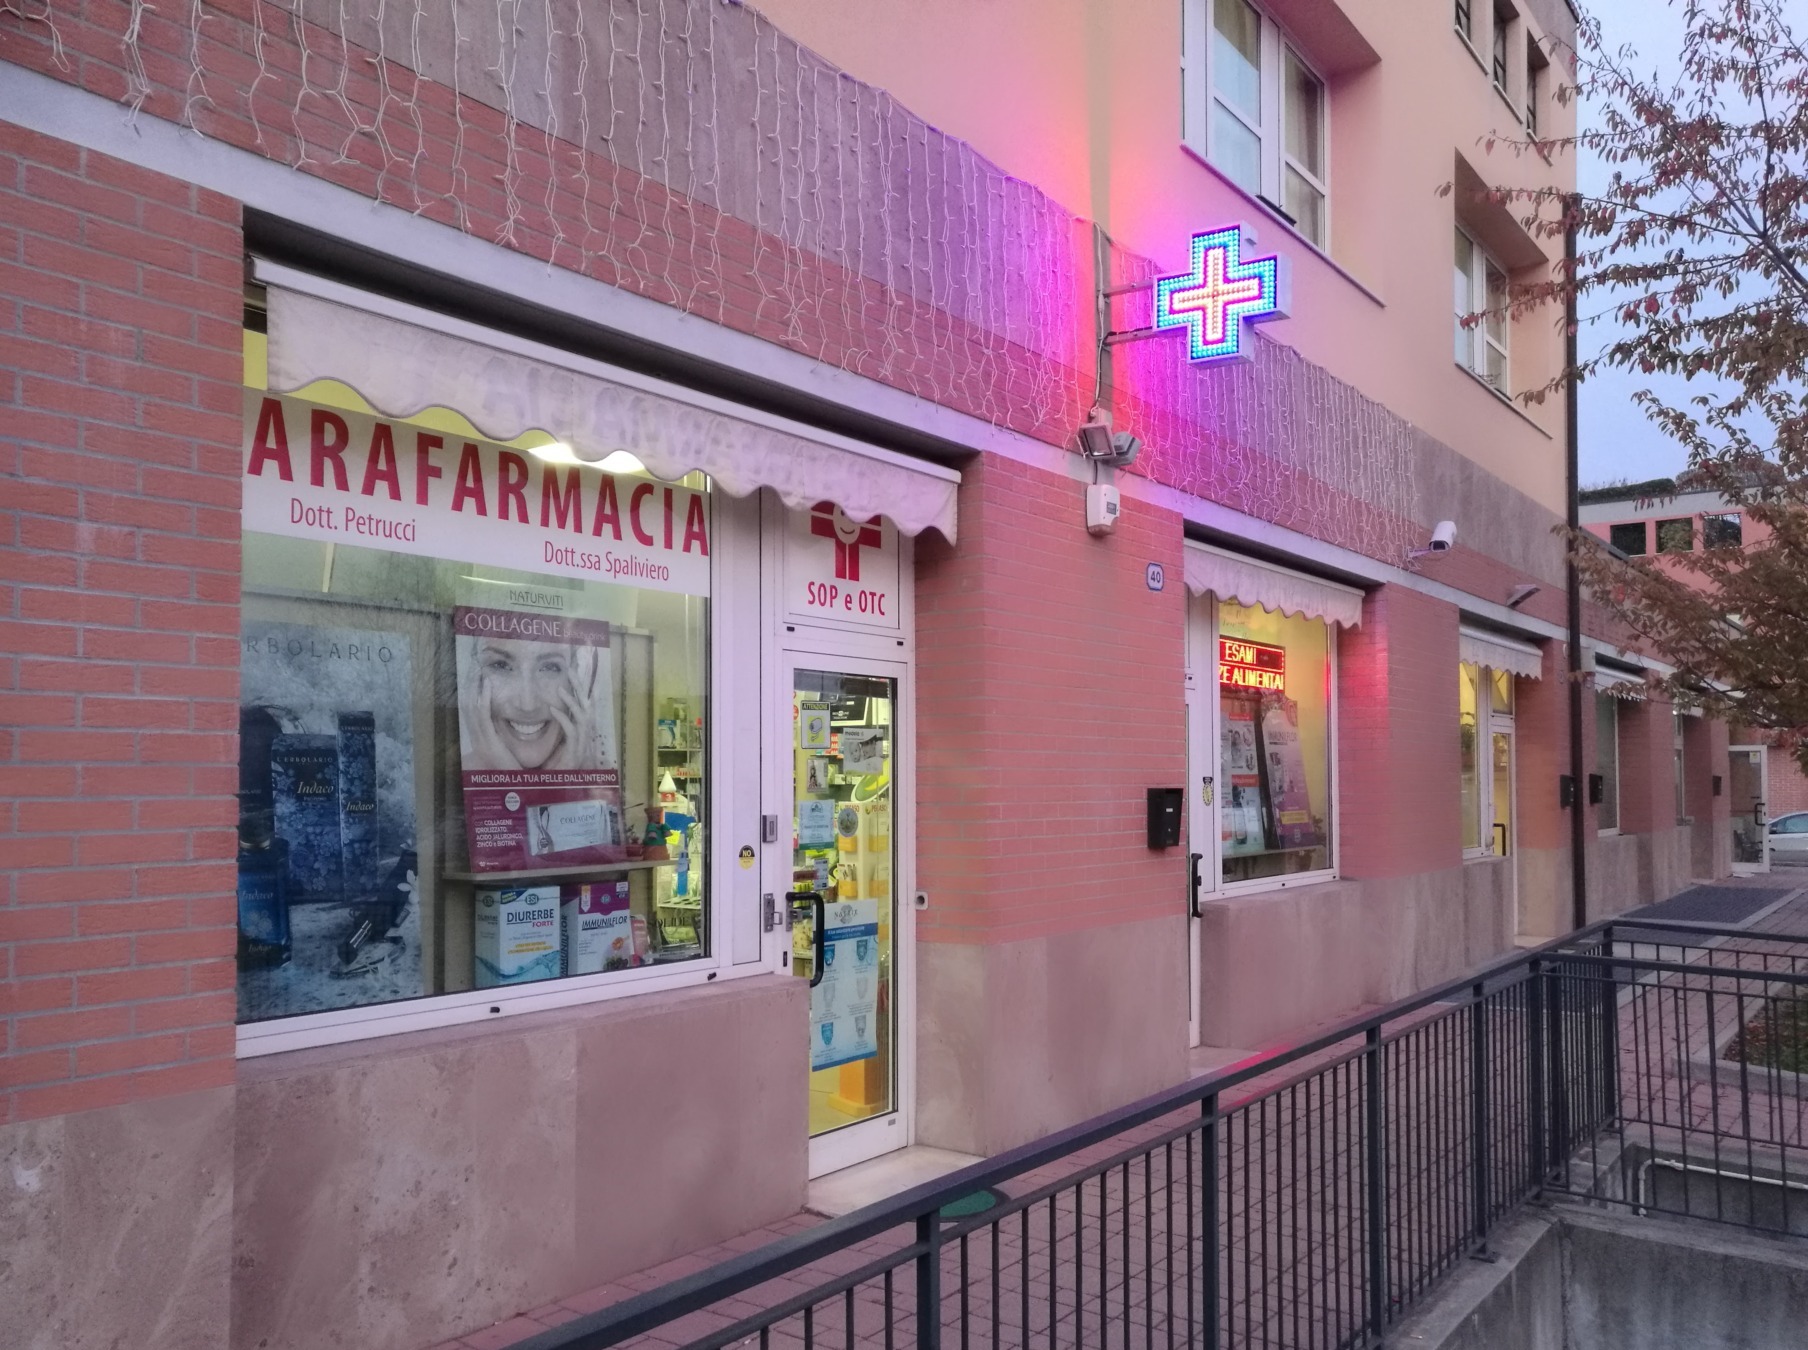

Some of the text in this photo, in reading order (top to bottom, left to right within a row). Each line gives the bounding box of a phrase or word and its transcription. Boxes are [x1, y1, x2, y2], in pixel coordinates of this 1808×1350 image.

[290, 498, 416, 542] Dott. Petrucci
[544, 541, 669, 581] Dott.ssa Spaliviero
[1150, 571, 1161, 584] 40
[807, 581, 885, 616] SOP e OTC
[464, 612, 561, 638] COLLAGENE
[471, 773, 617, 783] MIGLIORA LA TUA PELLE DALL'INTERNO
[296, 781, 335, 795] Indaco
[346, 801, 375, 812] Indaco
[484, 819, 513, 827] COLLAGENE
[742, 849, 752, 857] NO
[506, 908, 555, 923] DIURERBE
[582, 915, 628, 928] IMMUNILFLOR
[532, 920, 554, 928] FORTE
